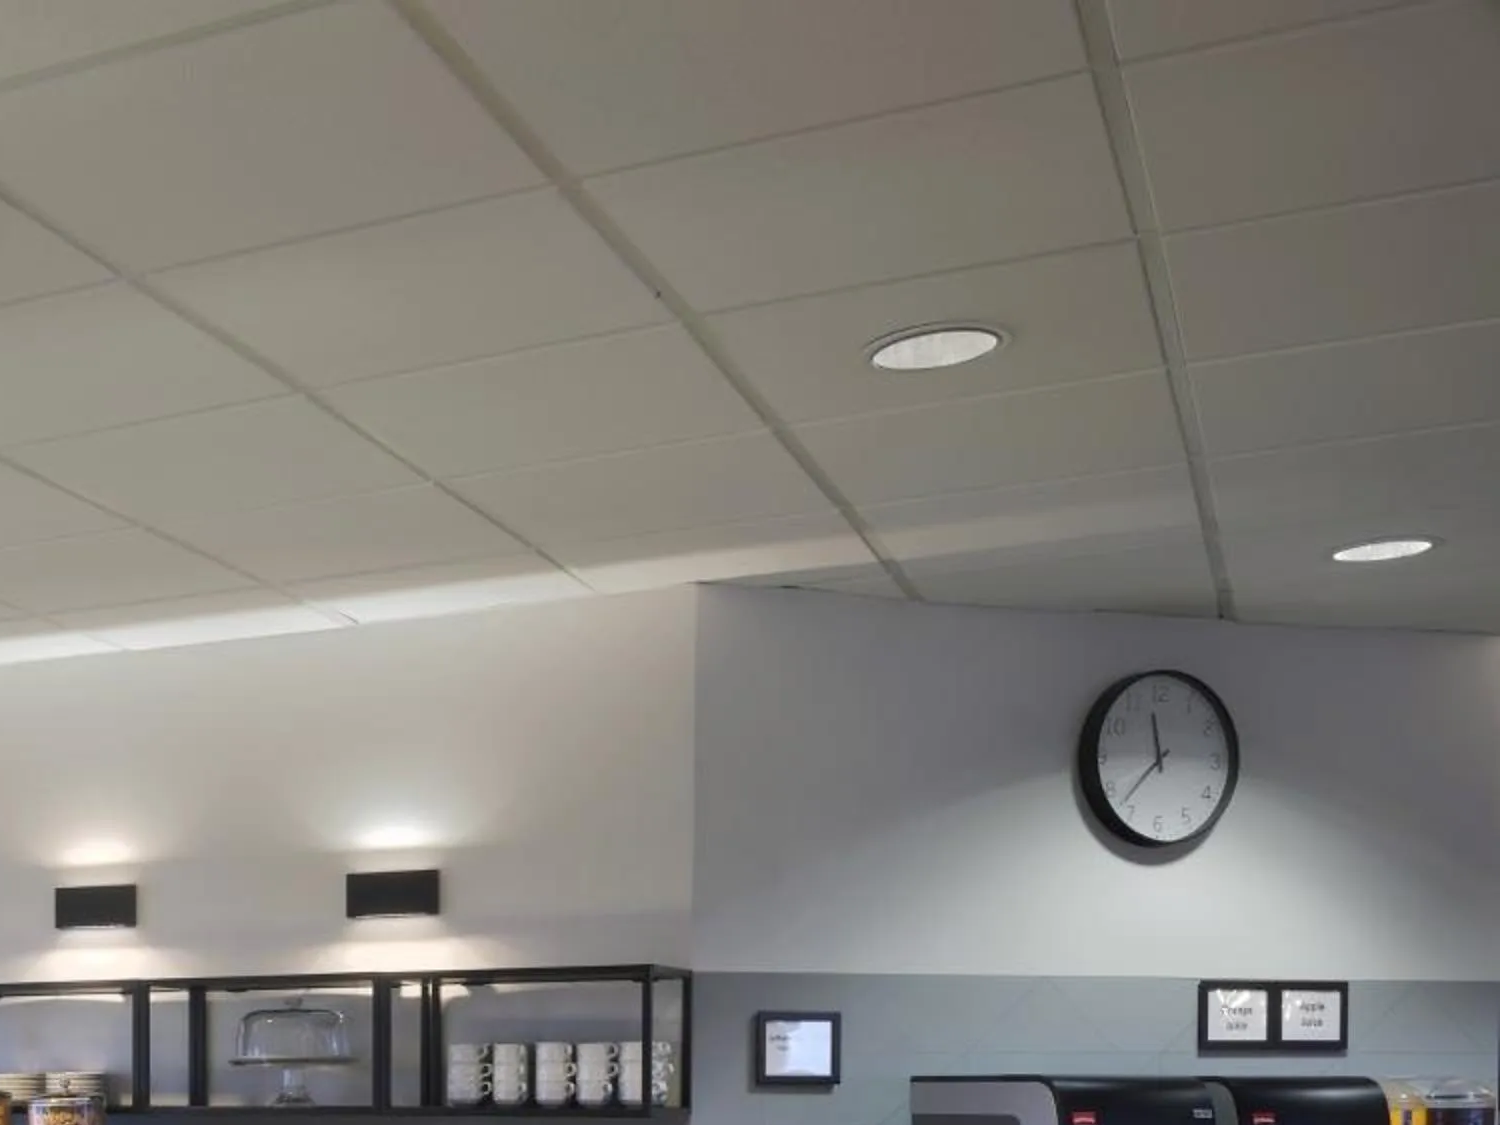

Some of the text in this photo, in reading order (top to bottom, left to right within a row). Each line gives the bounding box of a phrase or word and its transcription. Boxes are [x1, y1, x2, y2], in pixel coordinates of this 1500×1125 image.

[1152, 684, 1170, 703] 12
[1105, 718, 1126, 737] 10
[1210, 753, 1221, 771] 3
[1201, 785, 1212, 800] 4
[1126, 805, 1135, 821] 7
[1181, 807, 1192, 825] 5
[1152, 815, 1165, 833] 6
